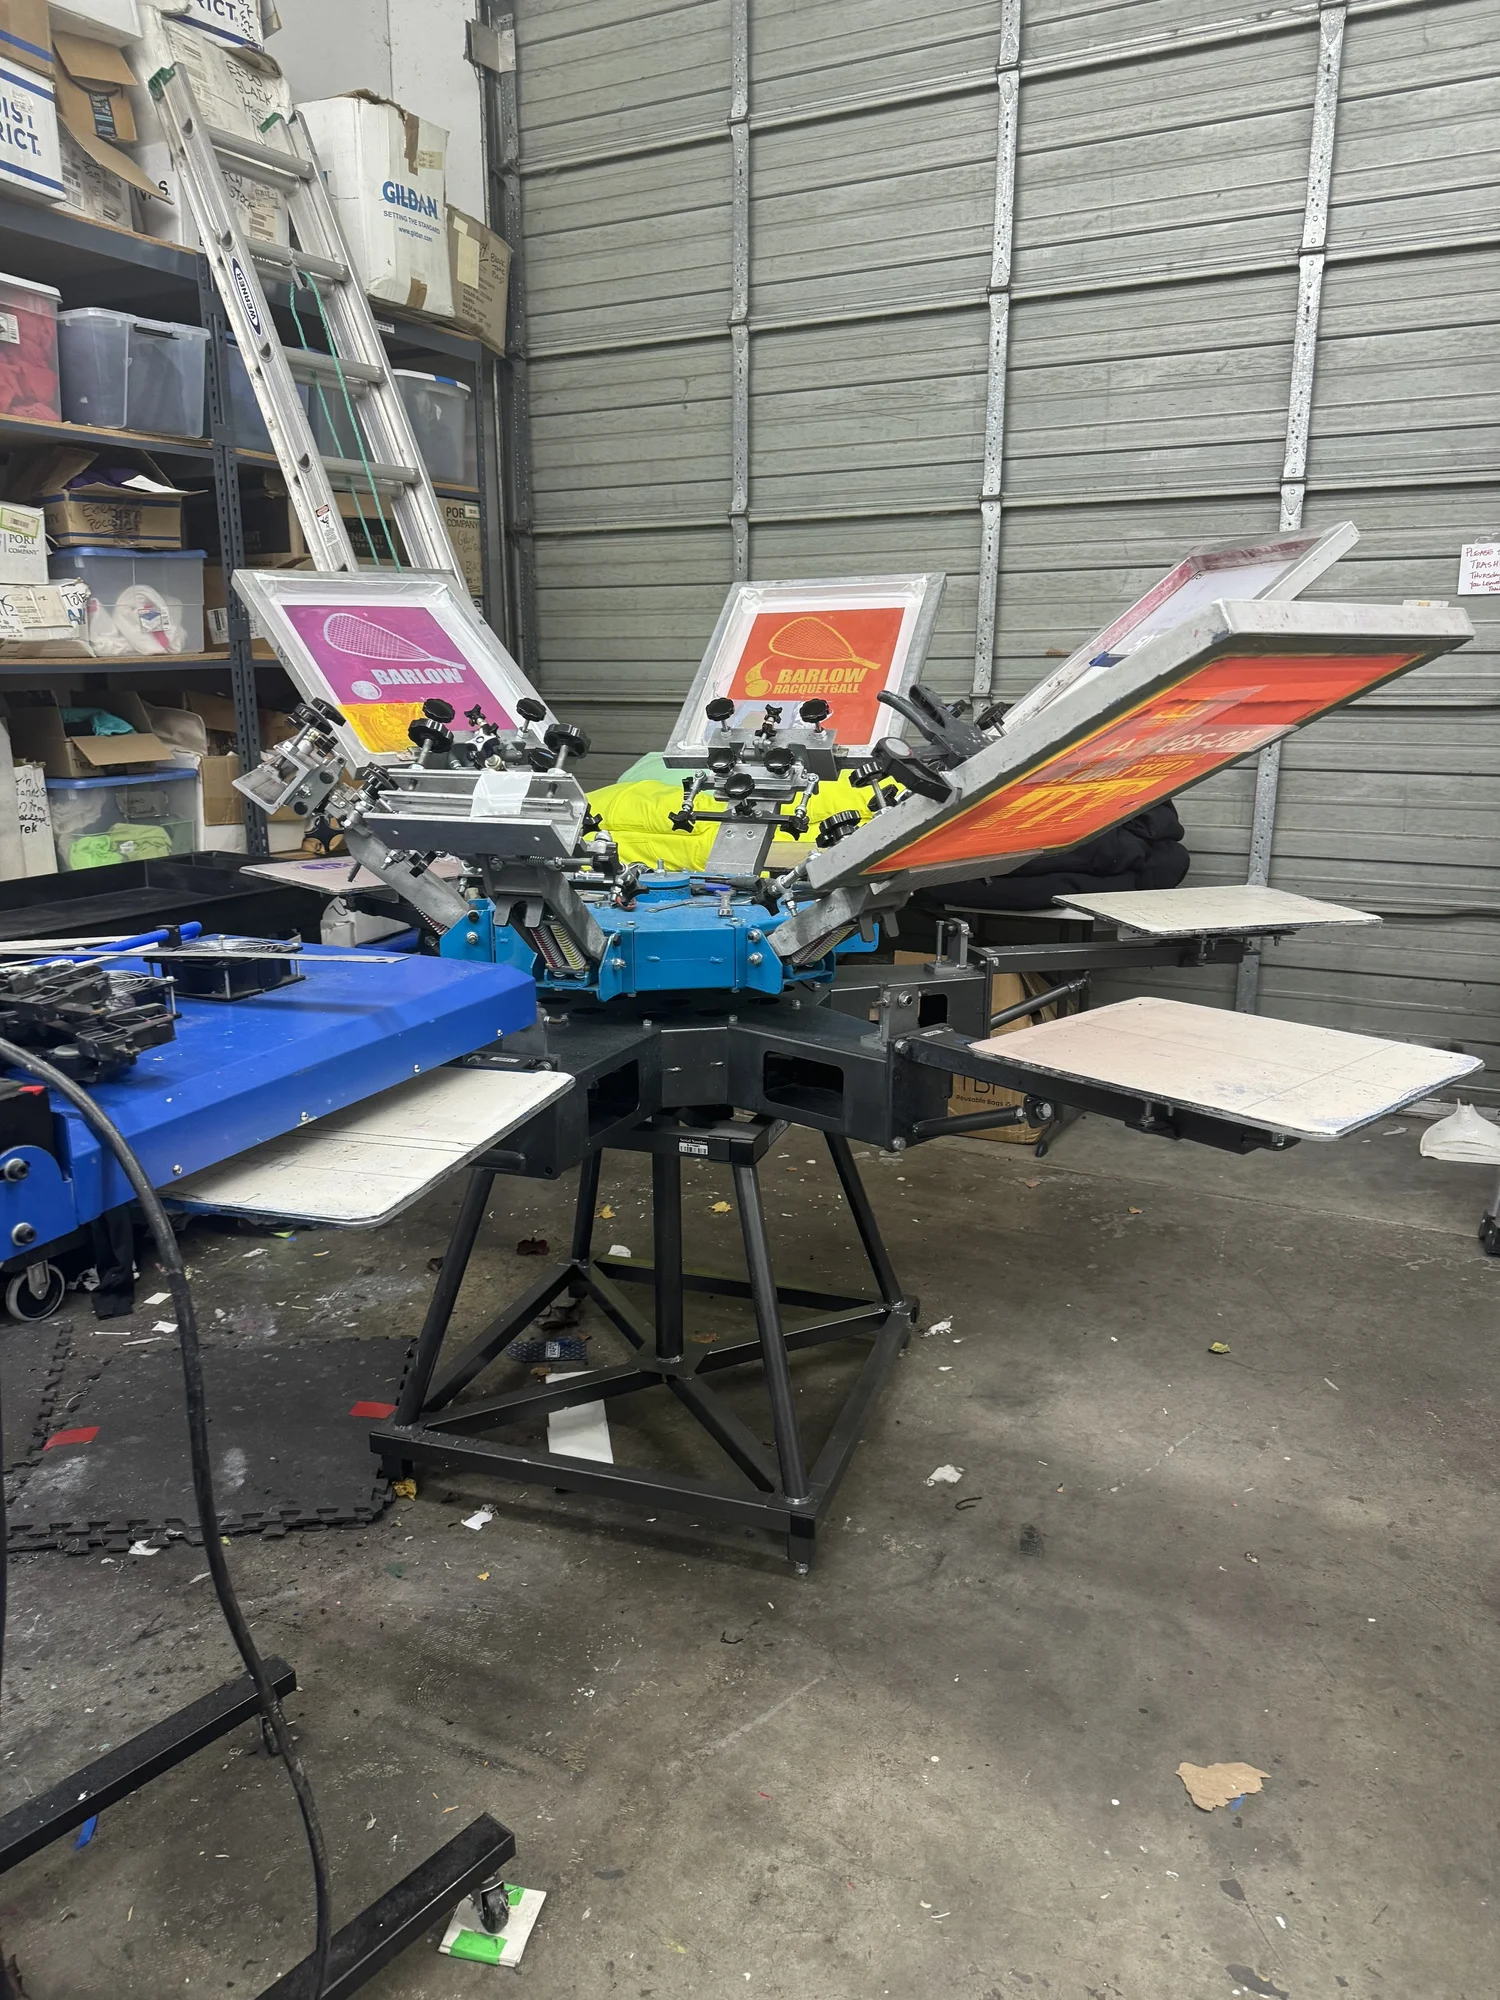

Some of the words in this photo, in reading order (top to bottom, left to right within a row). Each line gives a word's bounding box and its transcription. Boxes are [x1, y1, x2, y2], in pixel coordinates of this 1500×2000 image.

[382, 181, 438, 219] GILDAN
[383, 210, 408, 222] SETTING
[408, 216, 418, 226] THE
[418, 220, 441, 235] STANDARD
[398, 227, 433, 242] www.gildan.com
[236, 272, 257, 320] WERNER
[446, 507, 465, 518] POR
[446, 518, 480, 529] COMPANY
[8, 547, 37, 555] COMPANY
[1470, 559, 1498, 569] TRASH
[371, 667, 464, 685] BARLOW
[777, 667, 868, 684] BARLOW
[772, 683, 860, 694] RACQUETBALL
[956, 1094, 986, 1104] Reusable
[986, 1099, 1003, 1107] Bags
